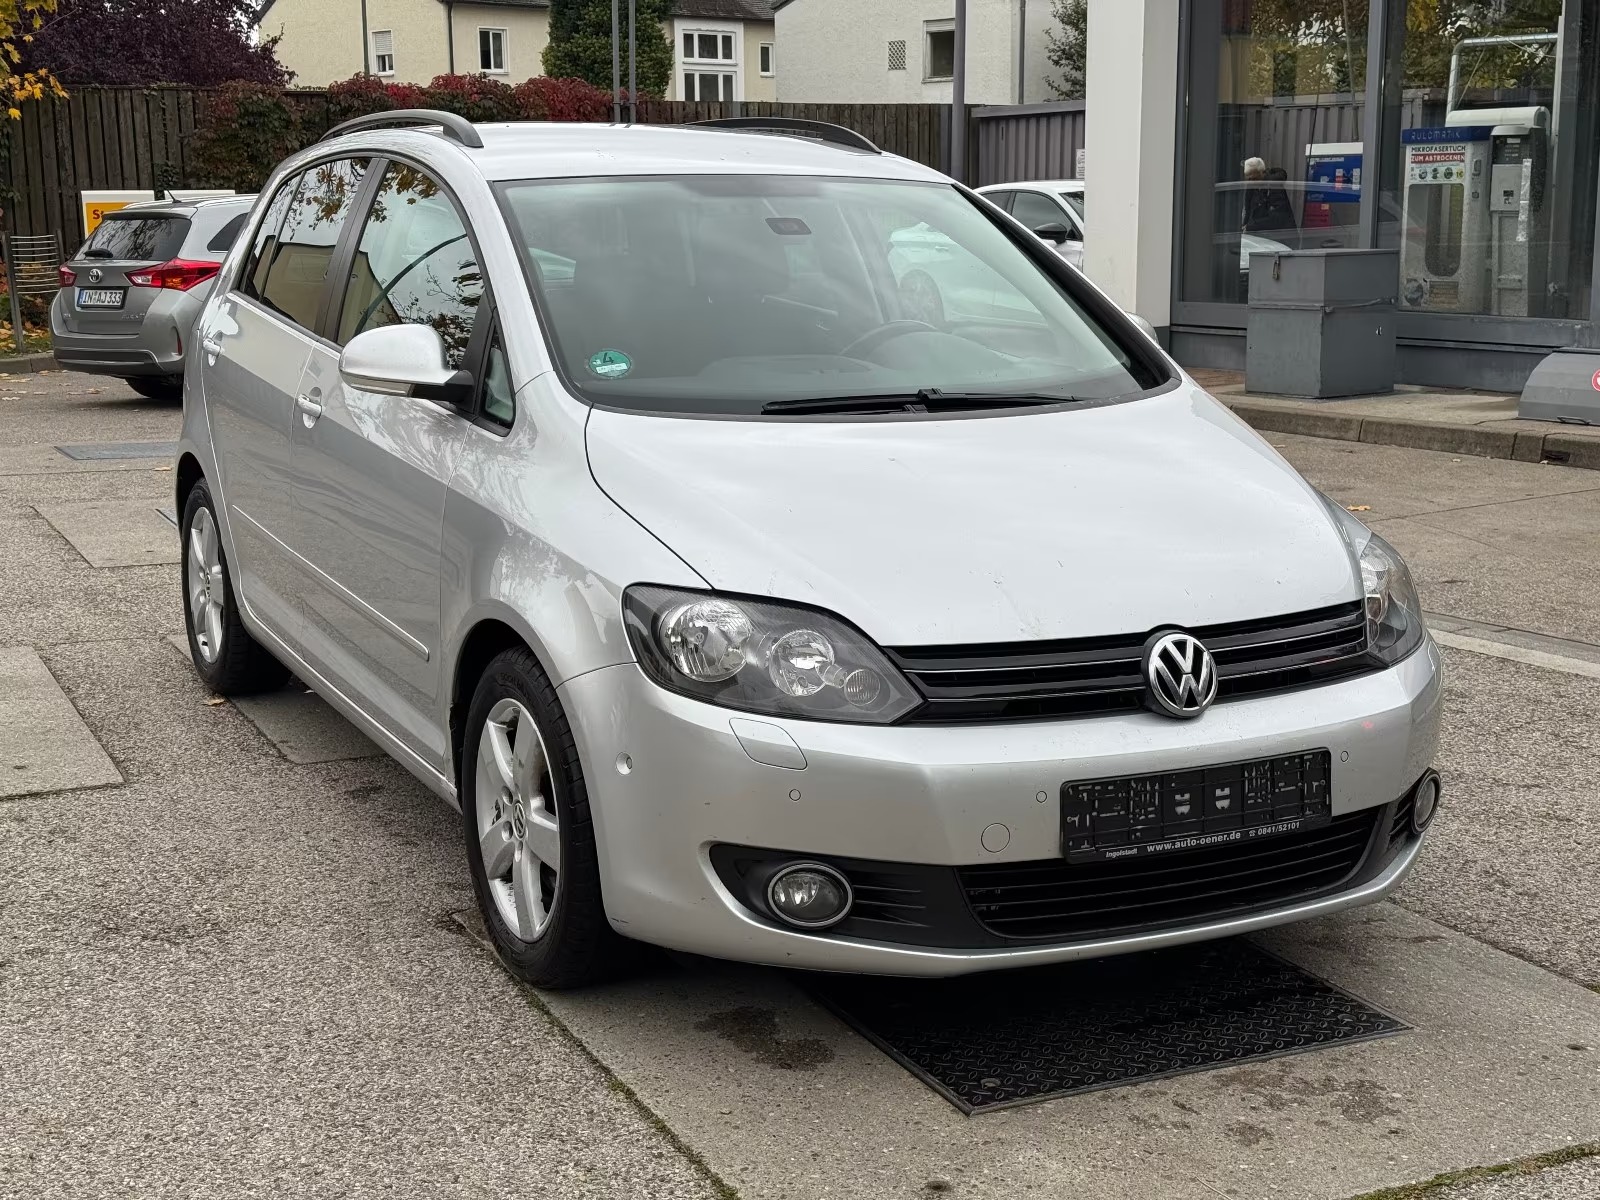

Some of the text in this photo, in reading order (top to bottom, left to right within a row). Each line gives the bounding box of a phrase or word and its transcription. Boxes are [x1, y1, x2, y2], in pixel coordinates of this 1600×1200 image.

[83, 291, 122, 304] IN AJ 333
[1106, 821, 1300, 858] Ingolstadt www.auto-oener.de 0841/52101
